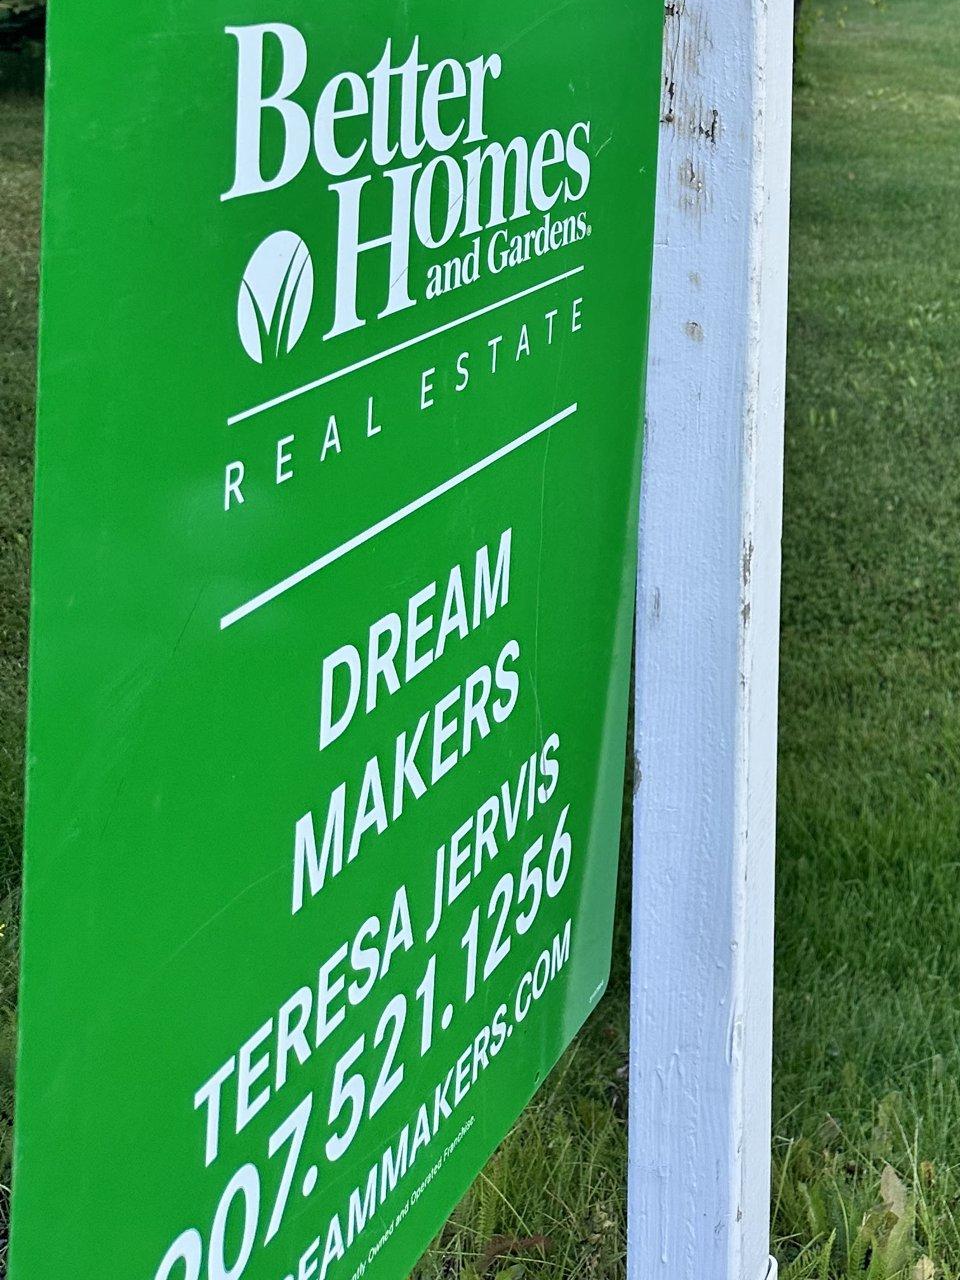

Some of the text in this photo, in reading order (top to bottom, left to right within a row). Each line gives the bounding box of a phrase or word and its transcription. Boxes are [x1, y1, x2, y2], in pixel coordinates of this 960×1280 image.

[220, 23, 501, 201] Better
[323, 121, 590, 341] Homes
[426, 237, 481, 299] and
[225, 298, 582, 511] REAL ESTATE
[320, 528, 511, 751] DREAM
[292, 640, 519, 915] MAKERS
[194, 733, 559, 1167] TERESA JERVIS
[284, 919, 571, 1280] EAMMAKERS.COM
[368, 1220, 394, 1263] Owned
[396, 1200, 410, 1227] and
[411, 1156, 442, 1206] Operated
